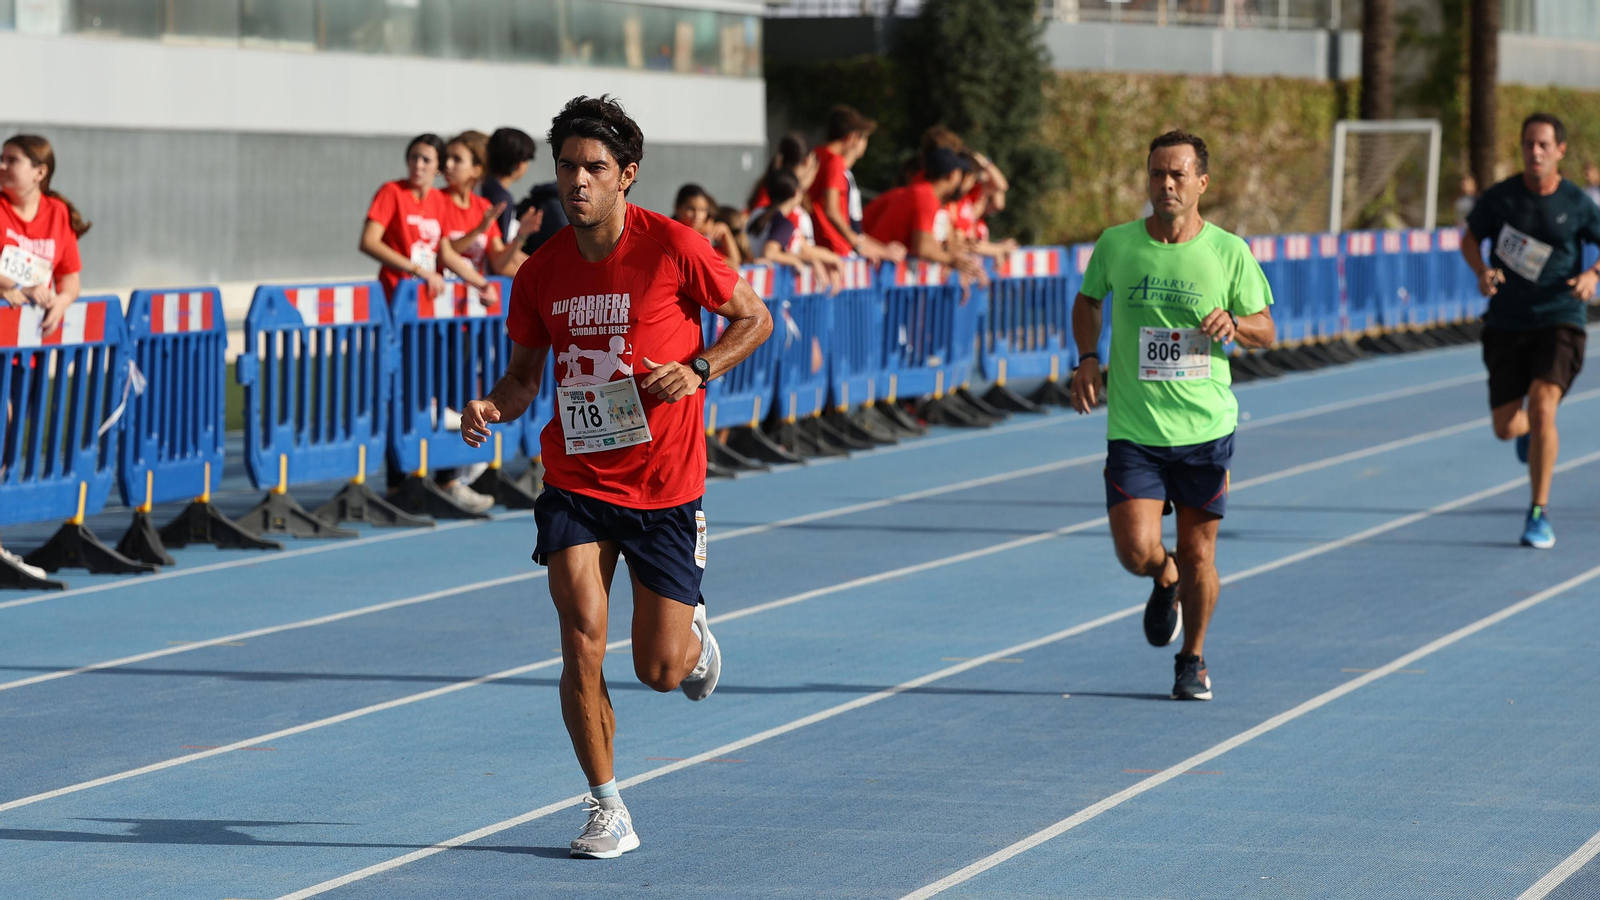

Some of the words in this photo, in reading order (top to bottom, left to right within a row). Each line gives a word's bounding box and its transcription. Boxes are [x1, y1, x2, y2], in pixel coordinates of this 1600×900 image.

[4, 257, 32, 281] 1536
[551, 299, 569, 315] XLII
[569, 293, 631, 312] CARRERA
[568, 308, 629, 326] POPULAR
[598, 326, 607, 335] DE
[1147, 342, 1181, 361] 806
[567, 404, 603, 430] 718
